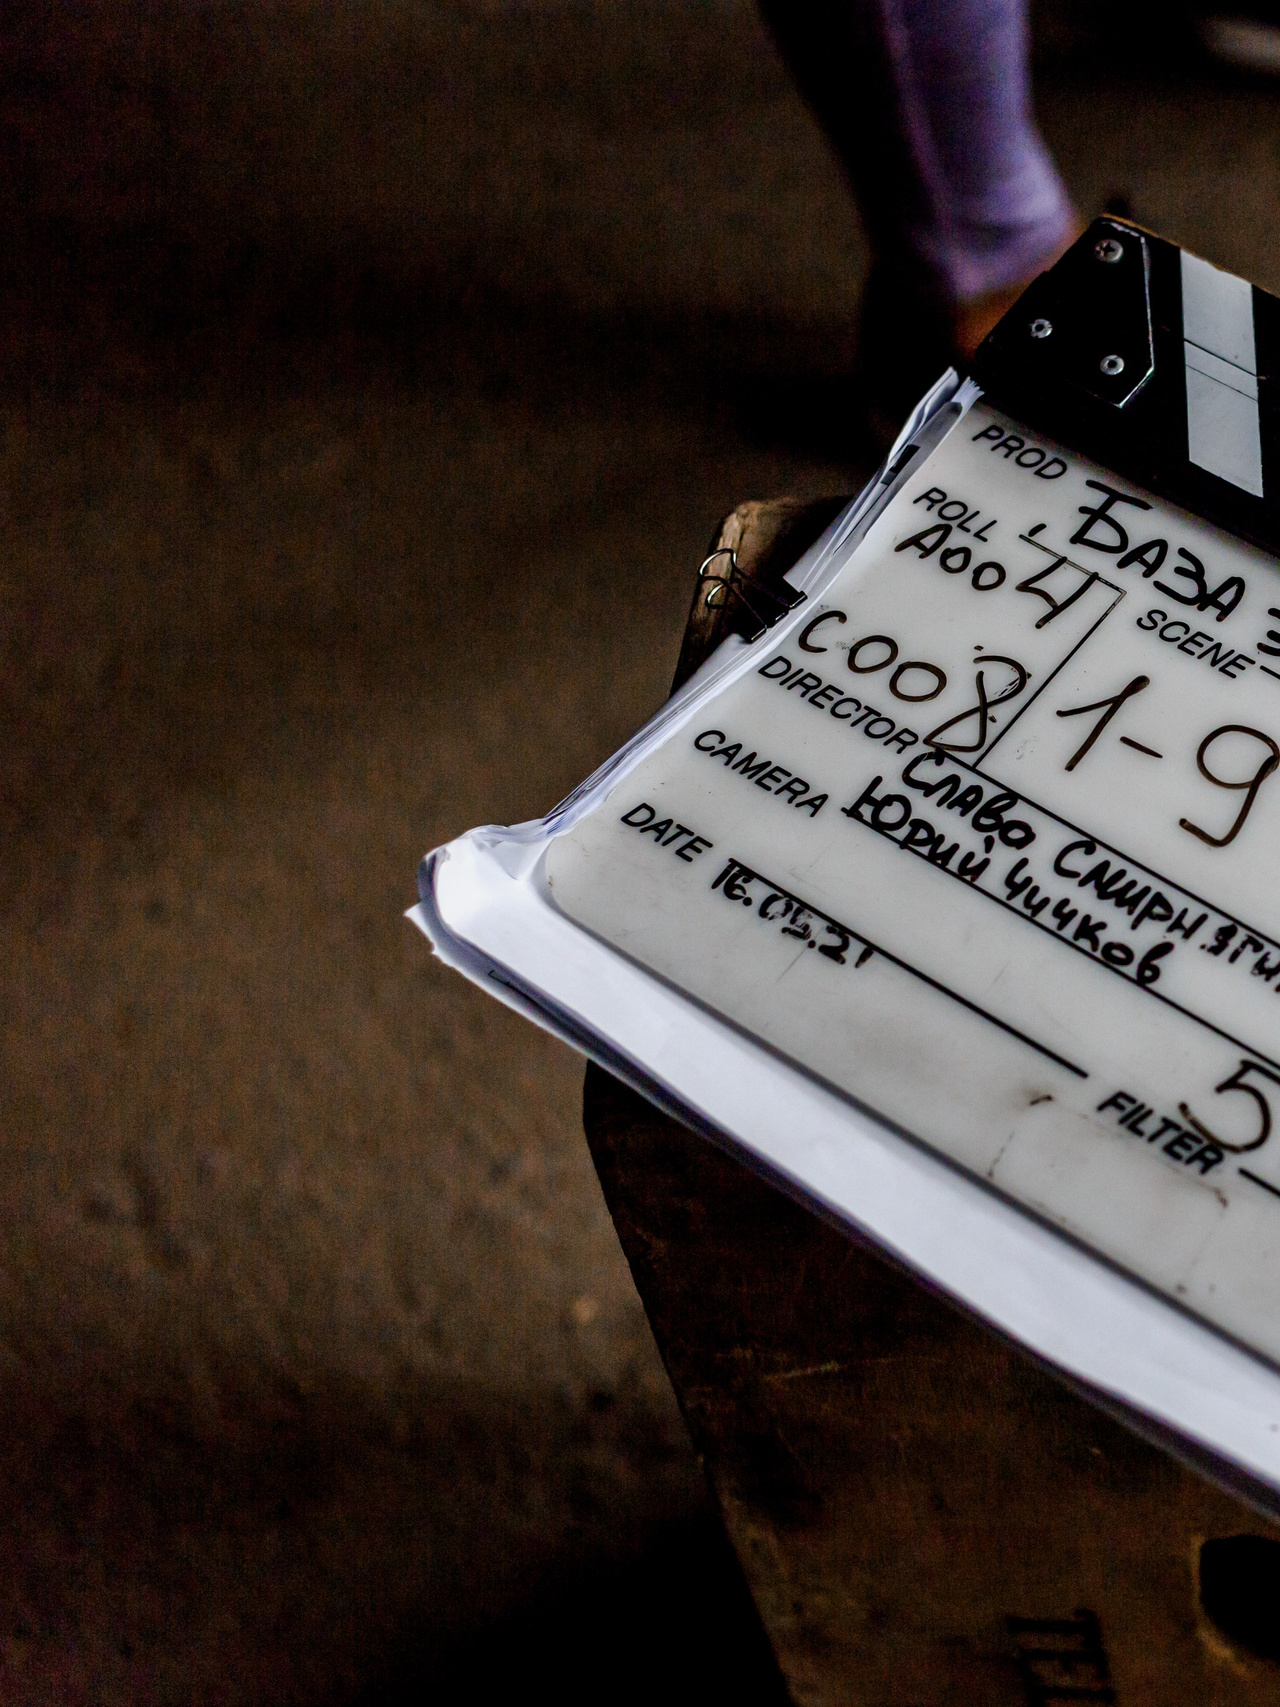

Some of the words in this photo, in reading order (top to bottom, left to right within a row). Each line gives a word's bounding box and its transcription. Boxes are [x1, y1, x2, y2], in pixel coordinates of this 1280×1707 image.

[972, 425, 1068, 480] PROD
[912, 487, 997, 542] ROLL
[1136, 608, 1256, 679] SCENE
[757, 655, 920, 755] DIRECTOR
[693, 729, 830, 818] CAMERA
[620, 802, 714, 863] DATE
[1096, 1090, 1225, 1175] FILTER
